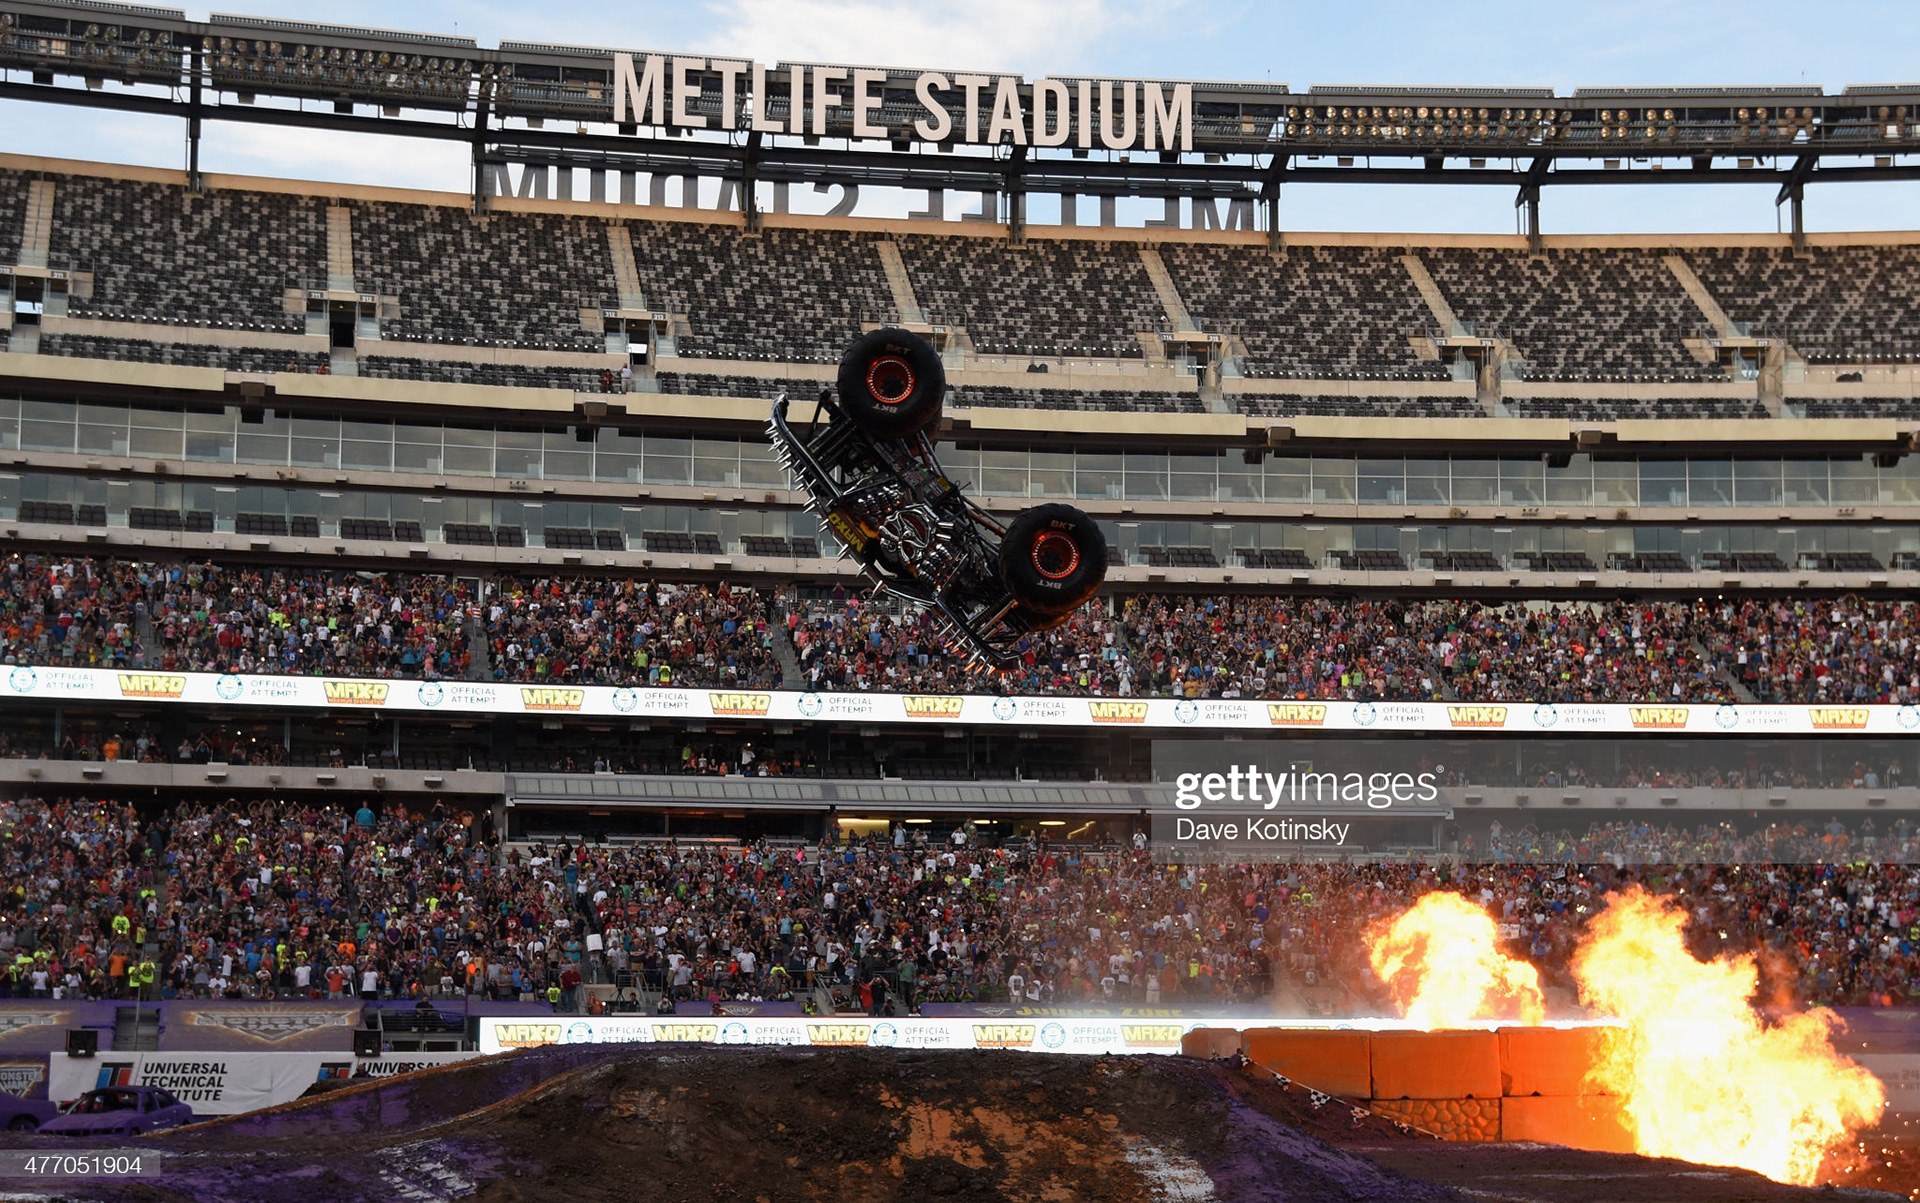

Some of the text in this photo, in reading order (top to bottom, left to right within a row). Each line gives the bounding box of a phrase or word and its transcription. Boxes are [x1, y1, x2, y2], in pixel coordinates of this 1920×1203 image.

[613, 52, 1193, 151] METLIFE STADIUM
[872, 403, 898, 414] BKT
[1051, 519, 1076, 531] BKT
[1036, 579, 1062, 590] BKT
[250, 679, 299, 689] OFFICIAL
[251, 689, 299, 698] ATTEMPT
[450, 686, 497, 695] OFFICIAL
[451, 696, 497, 704] ATTEMPT
[644, 692, 689, 701] OFFICIAL
[829, 697, 874, 705] OFFICIAL
[645, 701, 690, 709] ATTEMPT
[1023, 701, 1067, 709] OFFICIAL
[1205, 704, 1249, 712] OFFICIAL
[1383, 706, 1425, 714] OFFICIAL
[601, 1026, 648, 1035] OFFICIAL
[755, 1026, 801, 1035] OFFICIAL
[904, 1027, 950, 1035] OFFICIAL
[1073, 1027, 1118, 1035] OFFICIAL
[905, 1036, 950, 1044] ATTEMPT
[1073, 1036, 1118, 1044] ATTEMPT
[144, 1063, 228, 1074] UNIVERSAL
[141, 1076, 225, 1088] TECHNICAL
